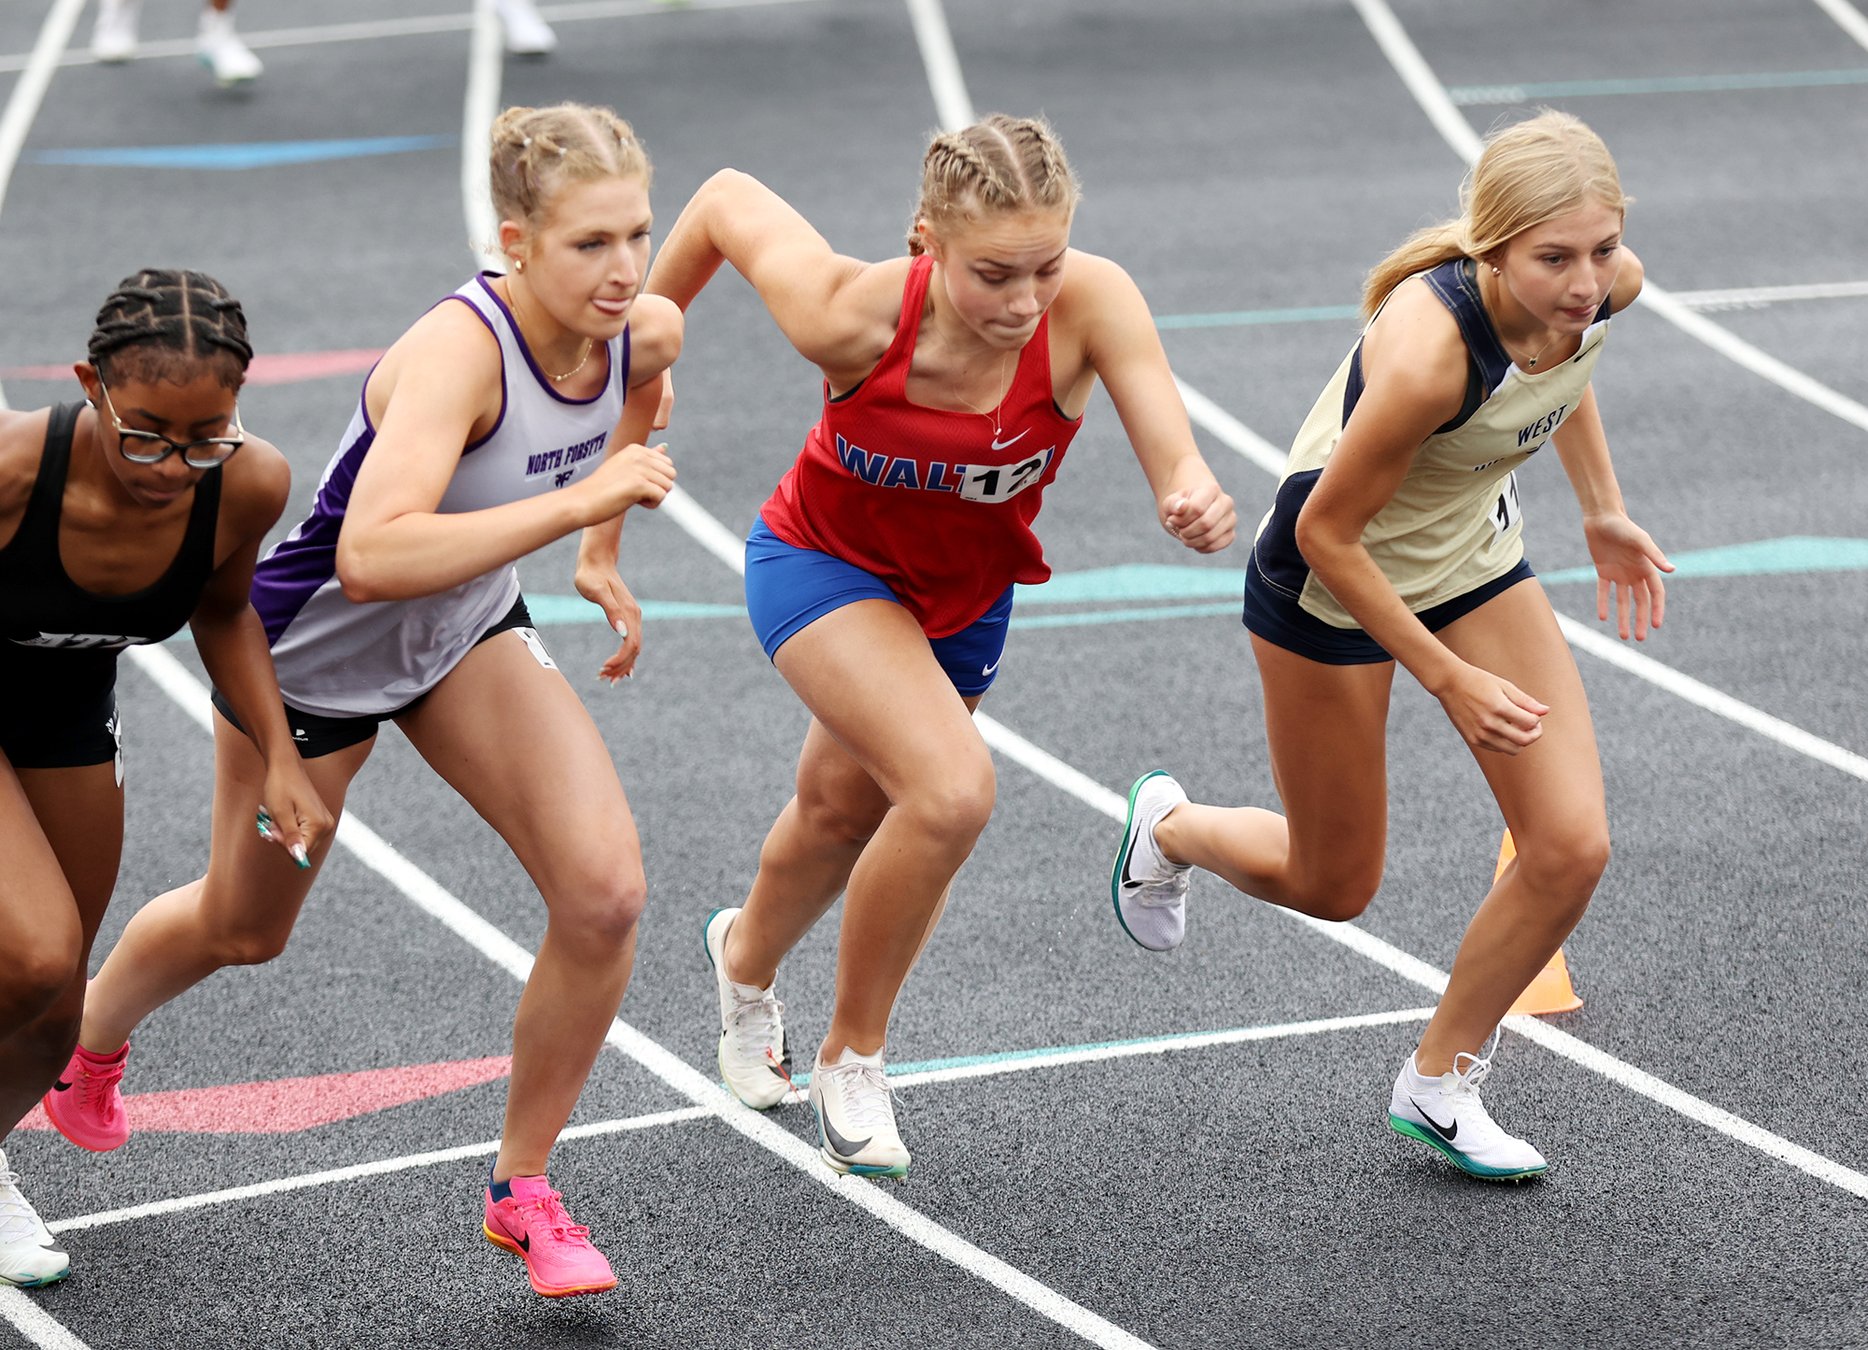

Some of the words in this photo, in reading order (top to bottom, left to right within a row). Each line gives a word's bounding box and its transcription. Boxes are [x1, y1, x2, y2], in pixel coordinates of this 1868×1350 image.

[1517, 404, 1568, 447] WEST
[526, 448, 563, 475] NORTH
[972, 458, 1042, 496] 12
